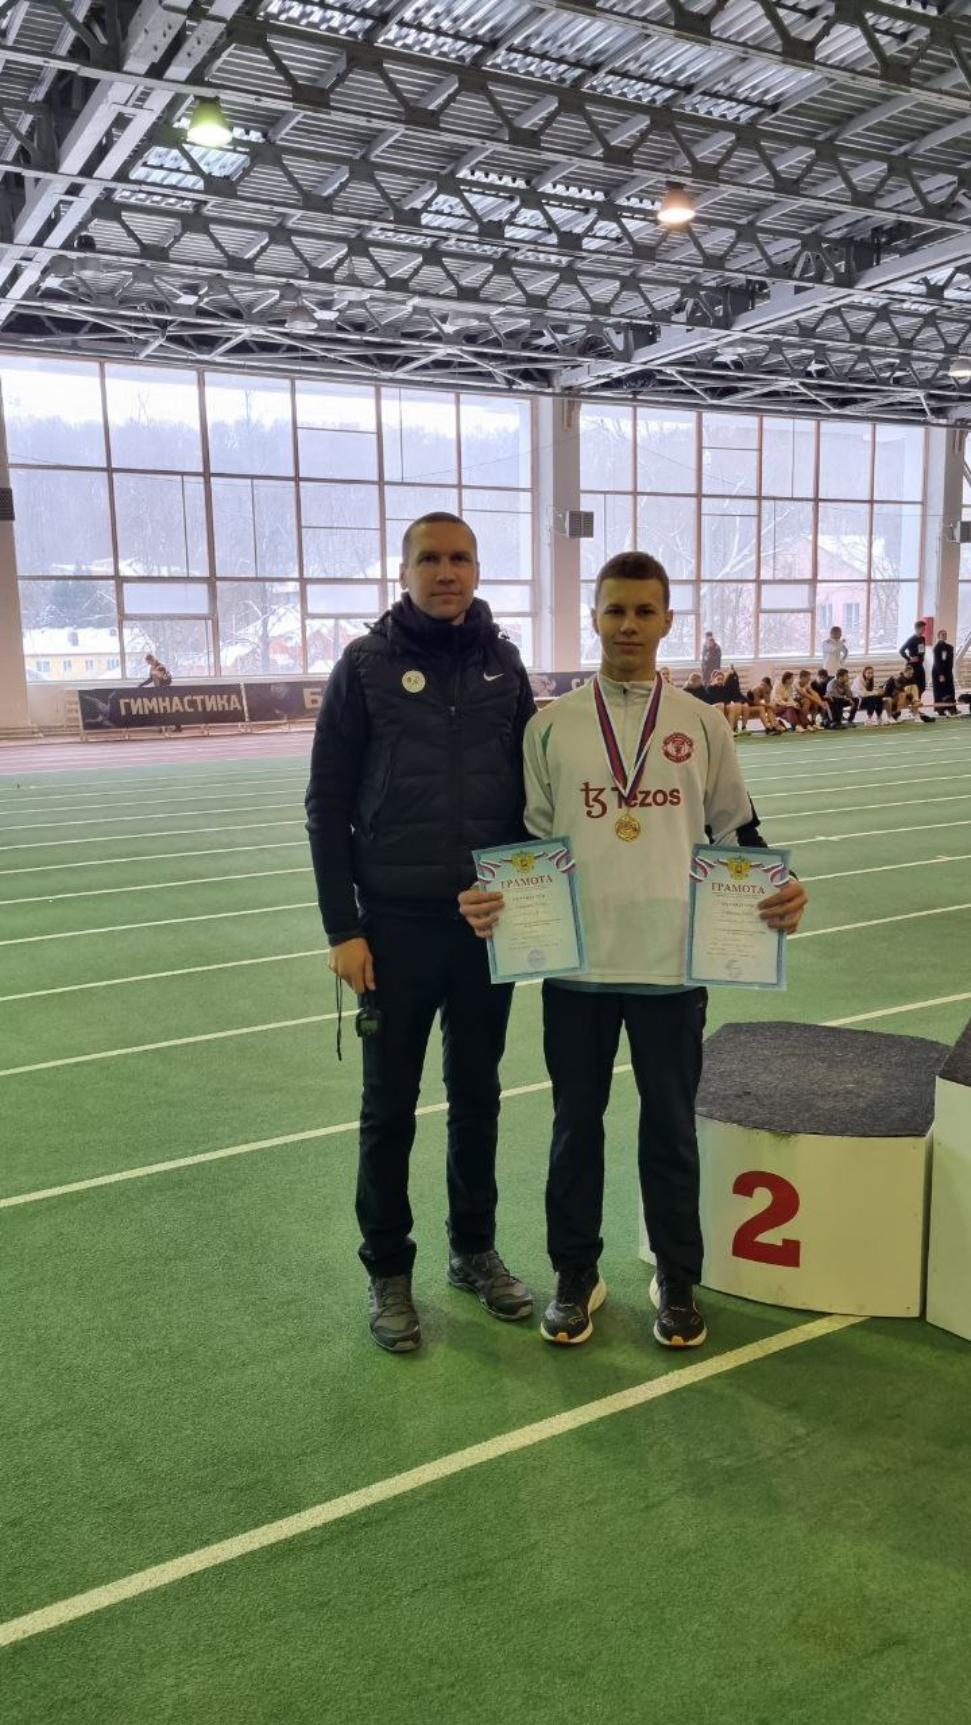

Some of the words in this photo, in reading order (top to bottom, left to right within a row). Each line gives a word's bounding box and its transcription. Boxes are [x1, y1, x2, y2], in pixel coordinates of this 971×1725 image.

[119, 694, 241, 716] ГИМНАСТИКА
[500, 874, 553, 890] ГРАМОТА
[711, 882, 765, 895] ГРАМОТА
[731, 1170, 801, 1268] 2
